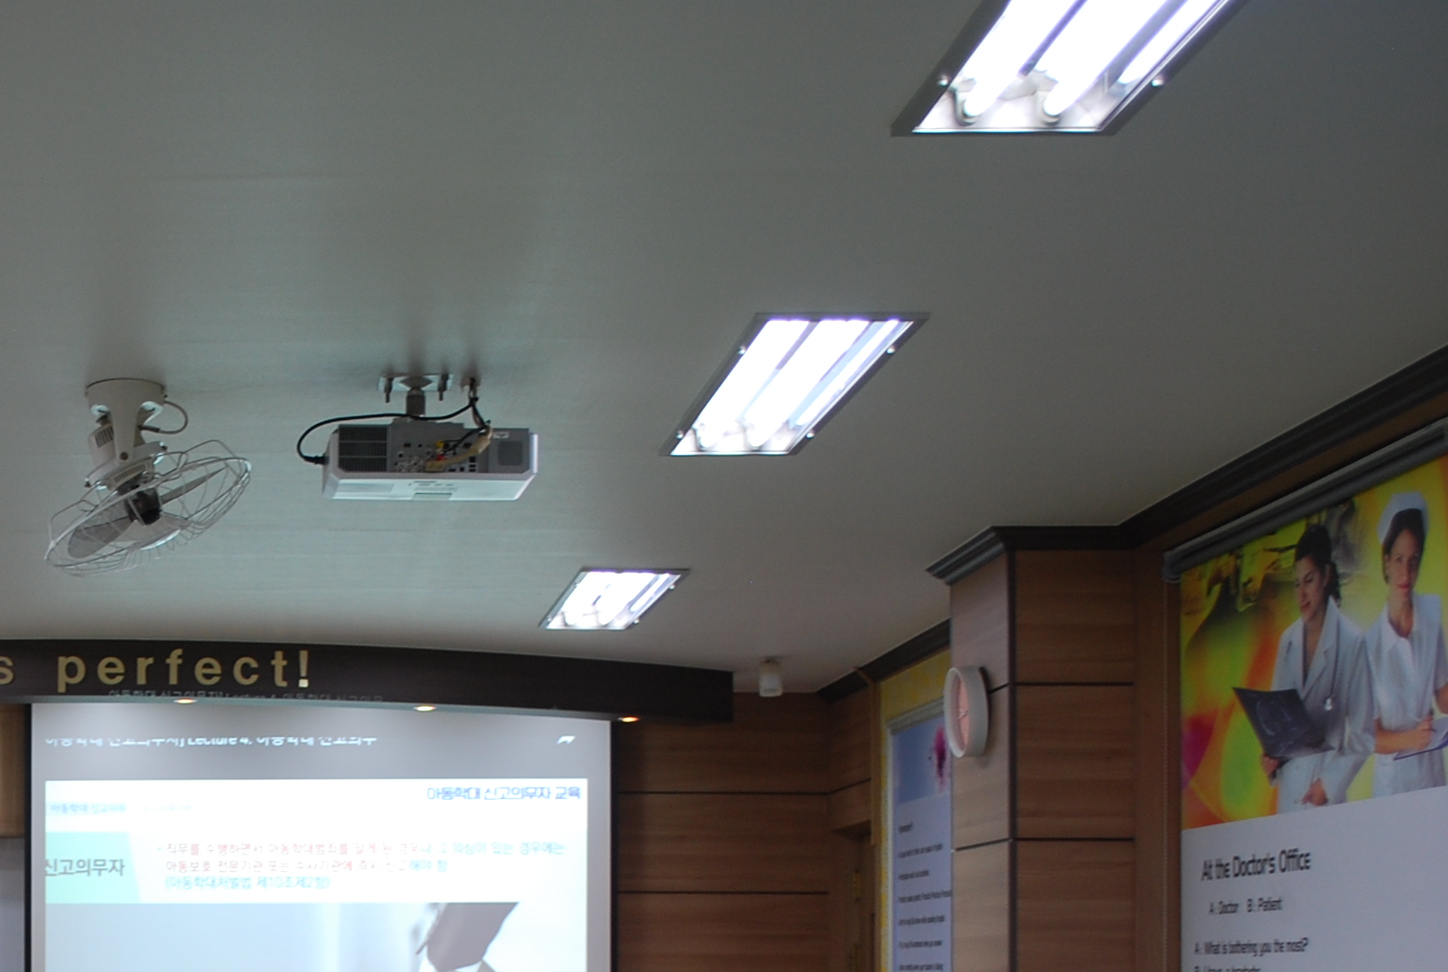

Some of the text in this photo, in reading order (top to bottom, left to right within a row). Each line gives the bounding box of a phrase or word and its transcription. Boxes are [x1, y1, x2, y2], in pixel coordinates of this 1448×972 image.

[57, 648, 309, 693] perfect!
[427, 787, 581, 800] 아동학대 신고의무자 교육
[166, 843, 199, 856] 직무를
[45, 858, 125, 877] 신고의무자
[166, 860, 211, 874] 아동보호
[218, 860, 262, 873] 전문기관
[1201, 847, 1311, 880] At the Doctor's Office
